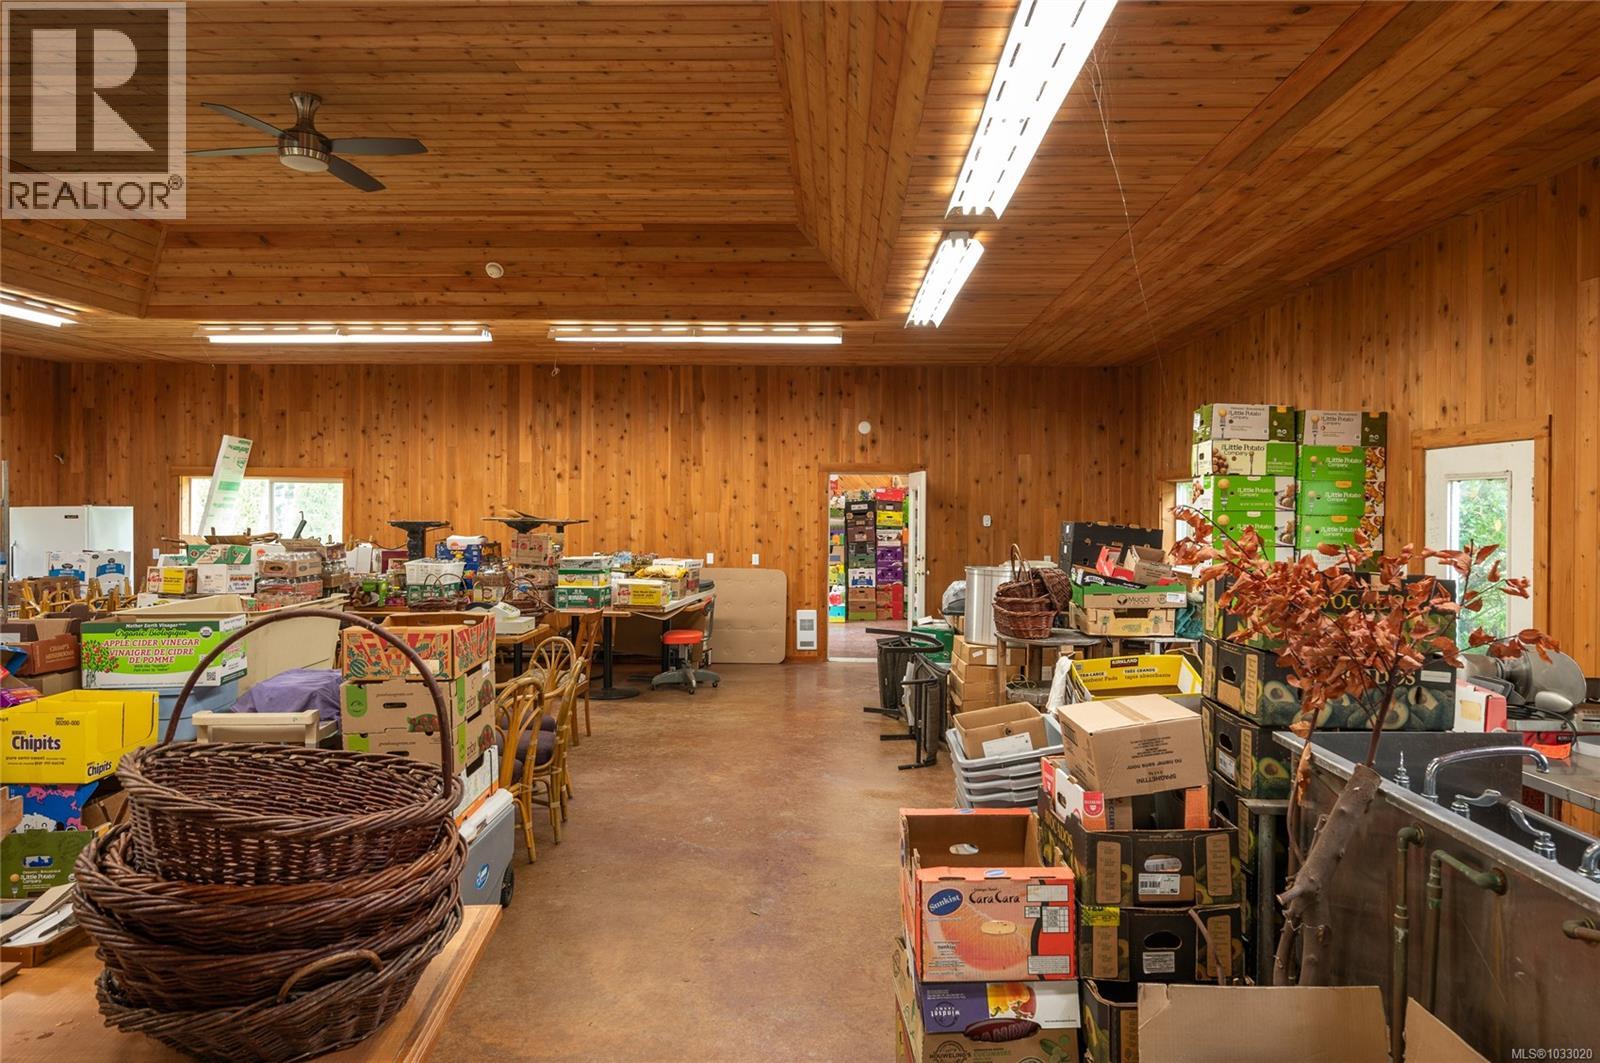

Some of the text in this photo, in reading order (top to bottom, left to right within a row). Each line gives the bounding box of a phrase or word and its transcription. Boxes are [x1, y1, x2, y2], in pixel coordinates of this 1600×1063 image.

[103, 638, 200, 647] APPLE CIDER VINEGAR
[109, 648, 194, 657] VINAIGRE DE CIDRE
[128, 655, 175, 664] DE POMME
[12, 734, 61, 752] Chipits
[87, 761, 112, 777] Chipits
[928, 894, 960, 911] Sunkist
